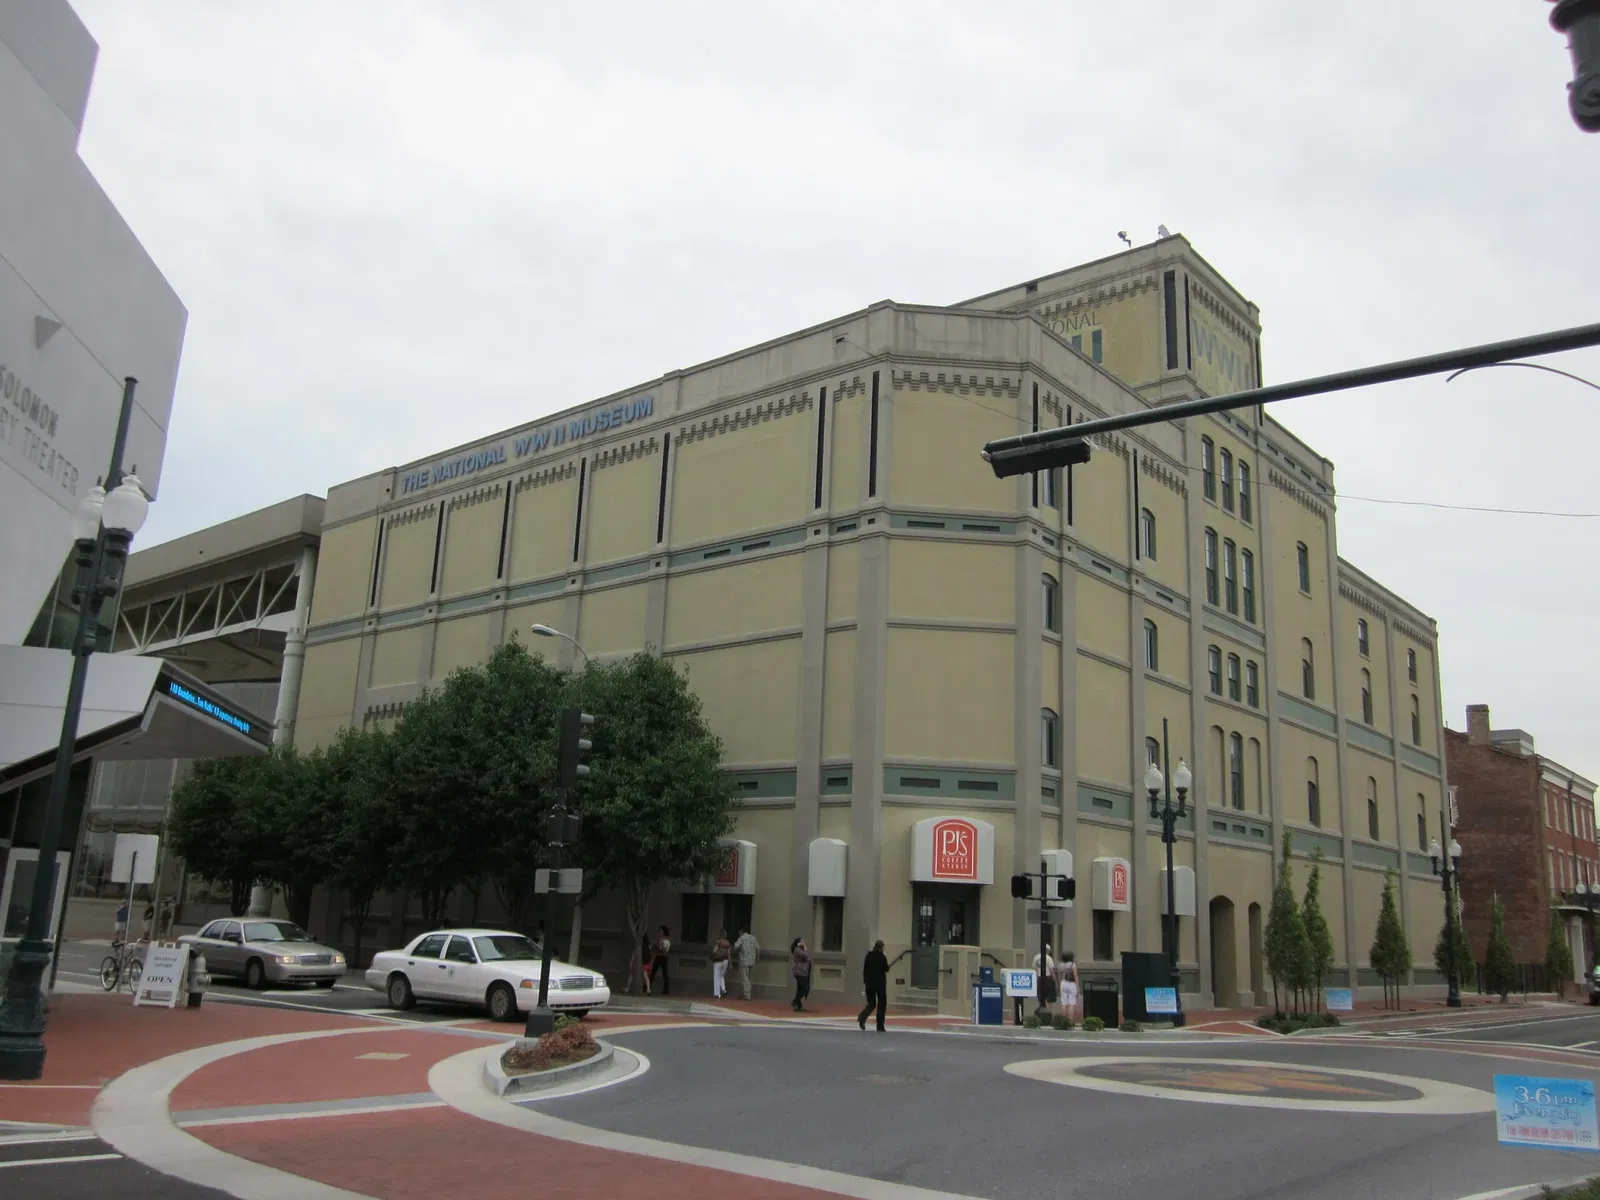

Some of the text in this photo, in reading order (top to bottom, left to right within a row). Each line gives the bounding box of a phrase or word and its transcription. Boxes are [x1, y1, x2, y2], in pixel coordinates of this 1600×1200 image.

[22, 426, 79, 496] THEATER
[403, 470, 429, 494] THE
[431, 446, 507, 485] NATIONAL
[568, 397, 654, 441] MUSEUM
[1554, 1095, 1577, 1106] pm
